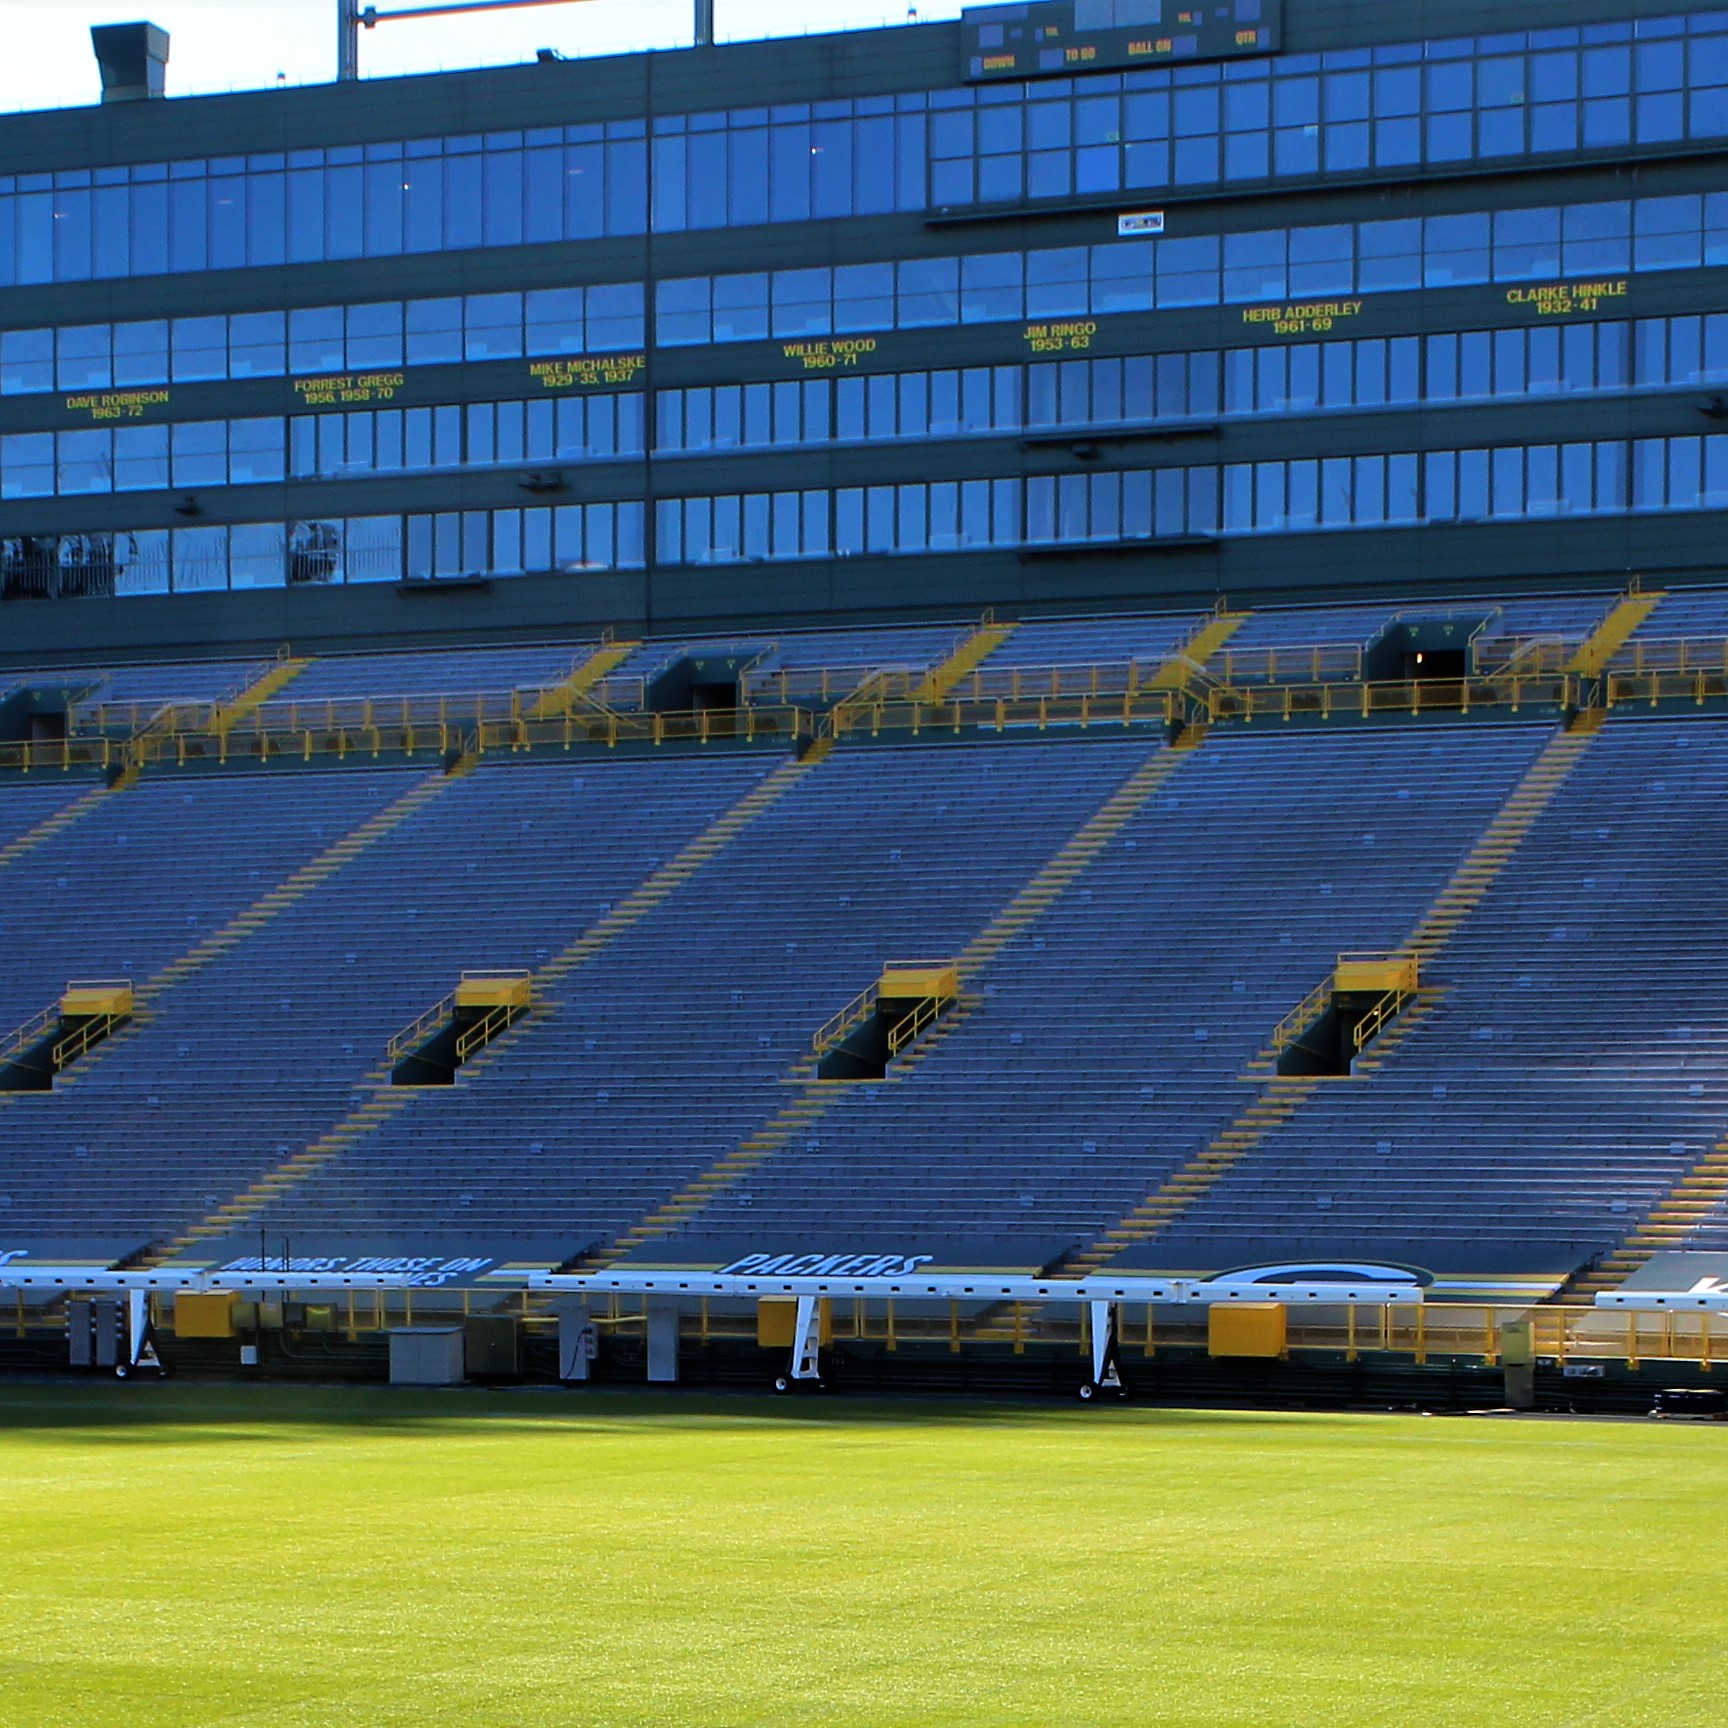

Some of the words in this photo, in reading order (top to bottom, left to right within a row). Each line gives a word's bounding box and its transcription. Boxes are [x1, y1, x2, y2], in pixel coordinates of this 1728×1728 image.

[1507, 286, 1569, 303] CLARKE
[1573, 282, 1627, 298] HINKLE
[1244, 308, 1281, 322] HERB
[1285, 302, 1362, 320] ADDERLEY
[1024, 325, 1047, 339] JIM
[1052, 322, 1097, 336] RINGO
[784, 342, 828, 357] WILLIE
[832, 339, 876, 353] WOOD
[530, 362, 562, 376] MIKE
[567, 356, 646, 372] MICHALSKE
[295, 377, 355, 392] FORREST
[358, 374, 404, 389] GREGG
[605, 370, 633, 383] 1937
[67, 396, 98, 409] DAVE
[102, 391, 169, 406] ROBINSON
[305, 391, 336, 404] 1956,
[342, 1257, 445, 1272] THOSE
[438, 1257, 494, 1272] ON
[715, 1253, 934, 1277] PACKERS
